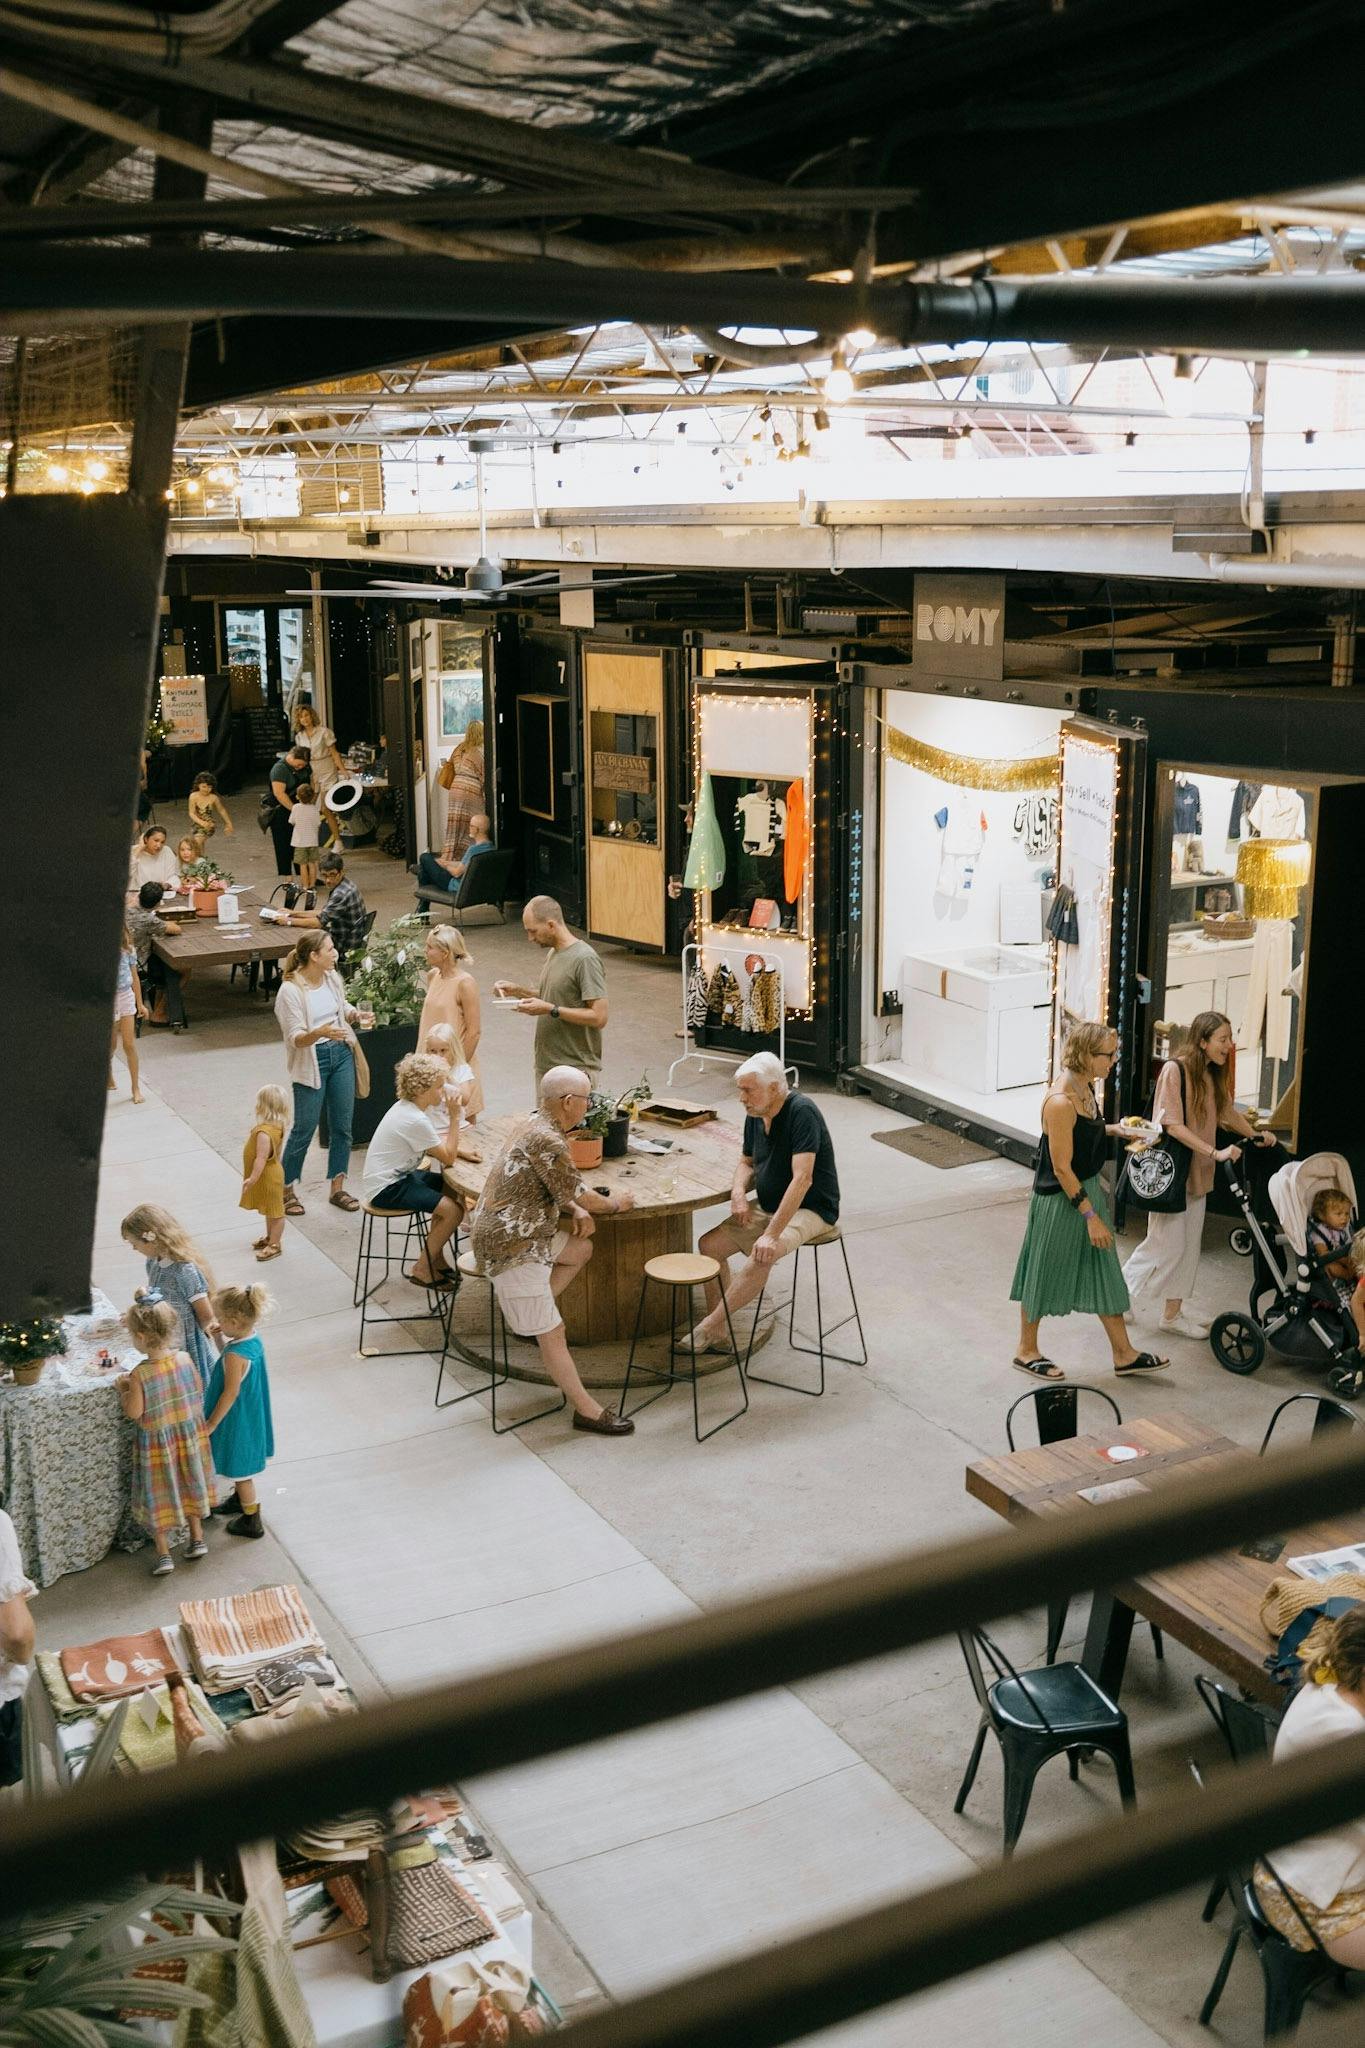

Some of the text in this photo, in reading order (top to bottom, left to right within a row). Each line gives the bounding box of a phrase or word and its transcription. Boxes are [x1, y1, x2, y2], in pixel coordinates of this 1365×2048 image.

[917, 604, 1000, 646] ROMY
[557, 660, 566, 684] 7
[166, 689, 198, 698] KNITWEAR
[1079, 786, 1091, 801] Sell
